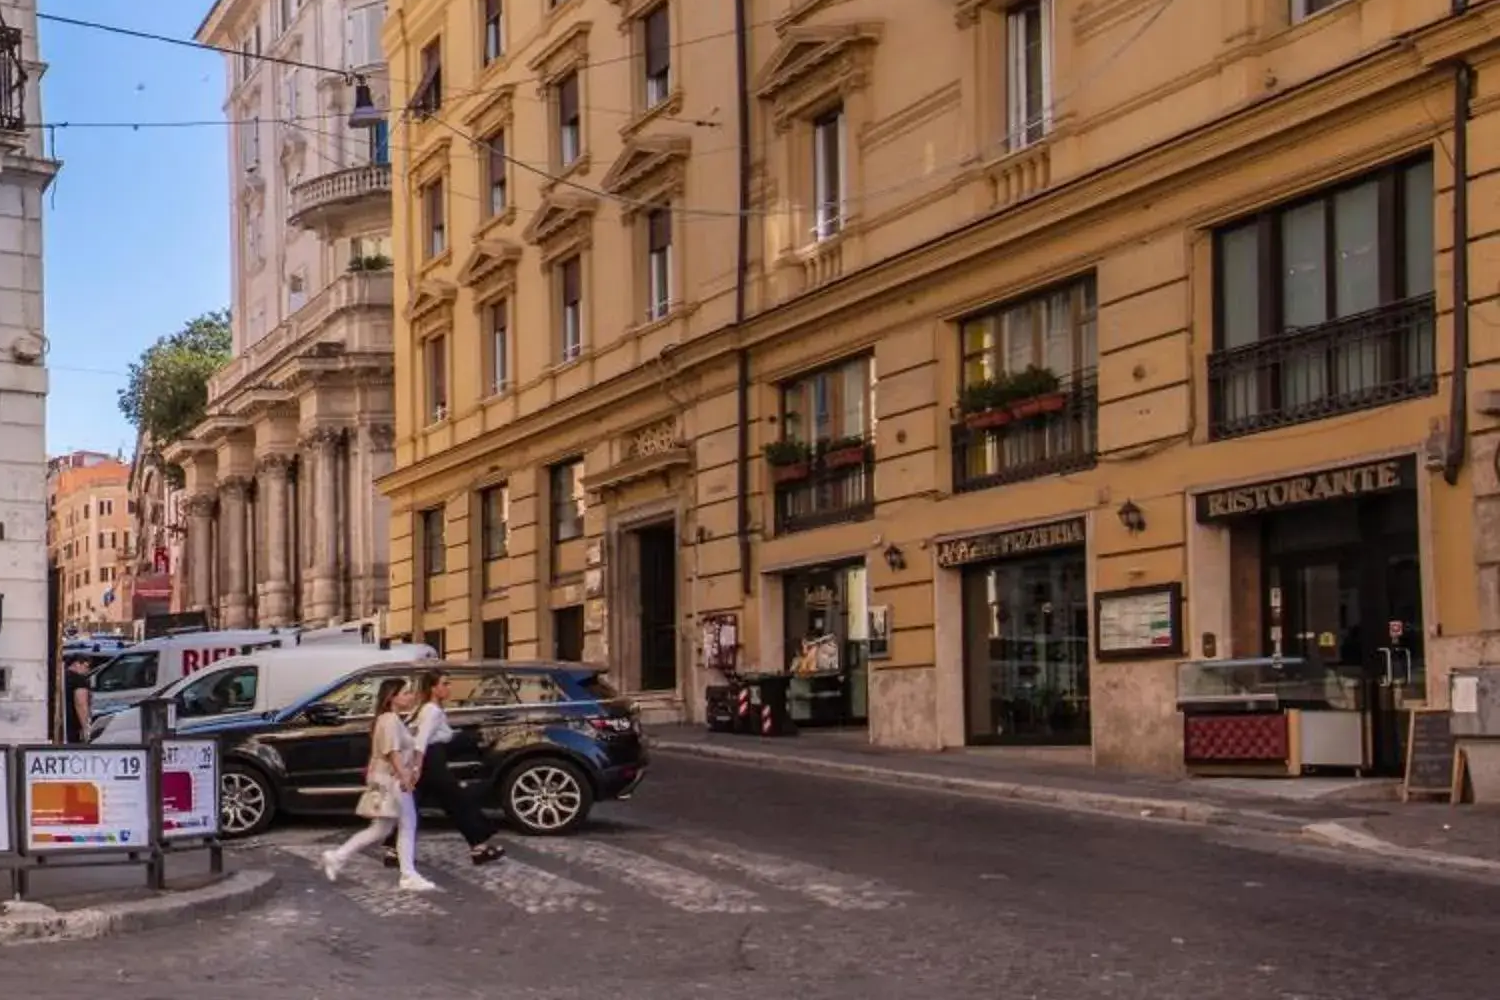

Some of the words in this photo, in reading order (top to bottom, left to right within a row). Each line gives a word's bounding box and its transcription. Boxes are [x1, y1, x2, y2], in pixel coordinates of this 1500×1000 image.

[1207, 461, 1401, 517] RISTORANTE
[30, 756, 113, 775] ARTCITY
[120, 757, 141, 774] 19
